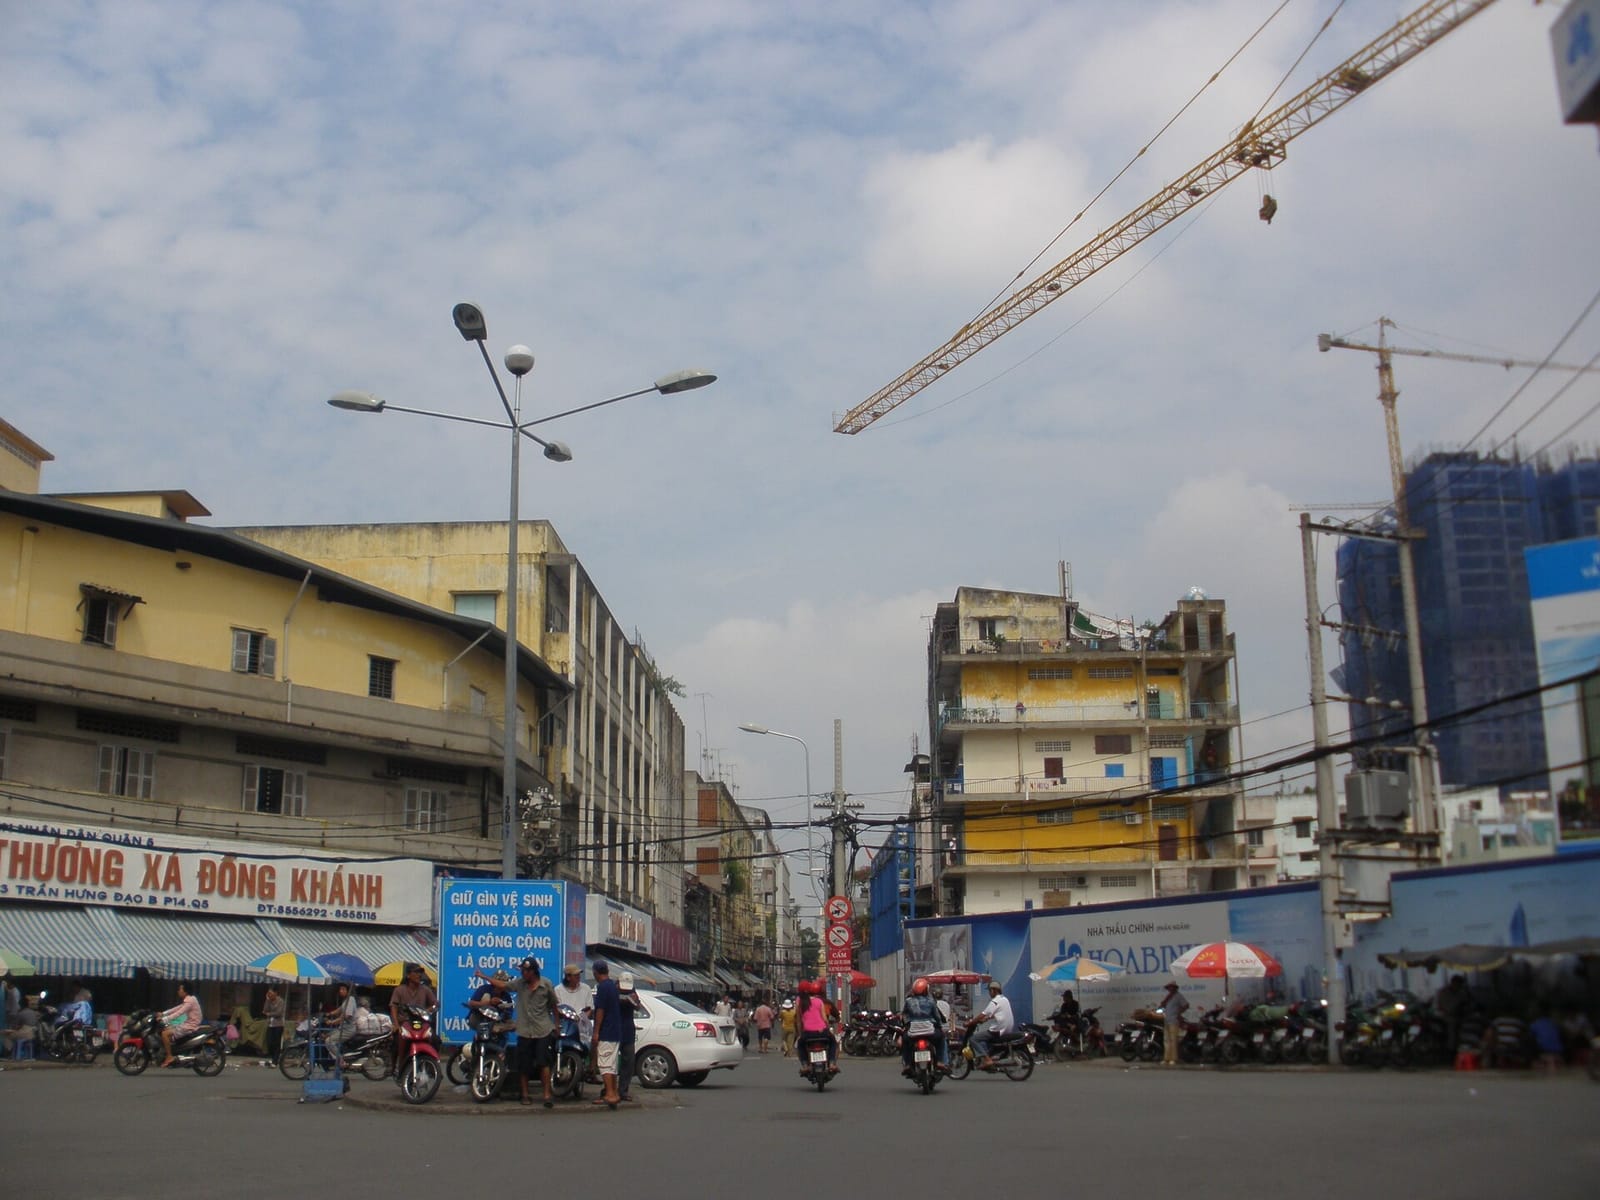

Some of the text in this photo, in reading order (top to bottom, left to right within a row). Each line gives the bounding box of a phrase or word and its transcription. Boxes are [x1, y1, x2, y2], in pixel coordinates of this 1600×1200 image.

[140, 850, 183, 893] XÁ
[290, 864, 384, 909] KHÁNH
[64, 888, 108, 900] HƯNG
[113, 893, 143, 906] ĐẠO
[148, 895, 158, 905] B
[450, 890, 553, 908] GIỮ GÌN VỆ SINH
[453, 910, 550, 927] KHÔNG XẢ RÁC
[452, 932, 552, 951] NƠI CÔNG CỘNG
[458, 952, 474, 968] LÀ
[478, 953, 505, 968] GÓP
